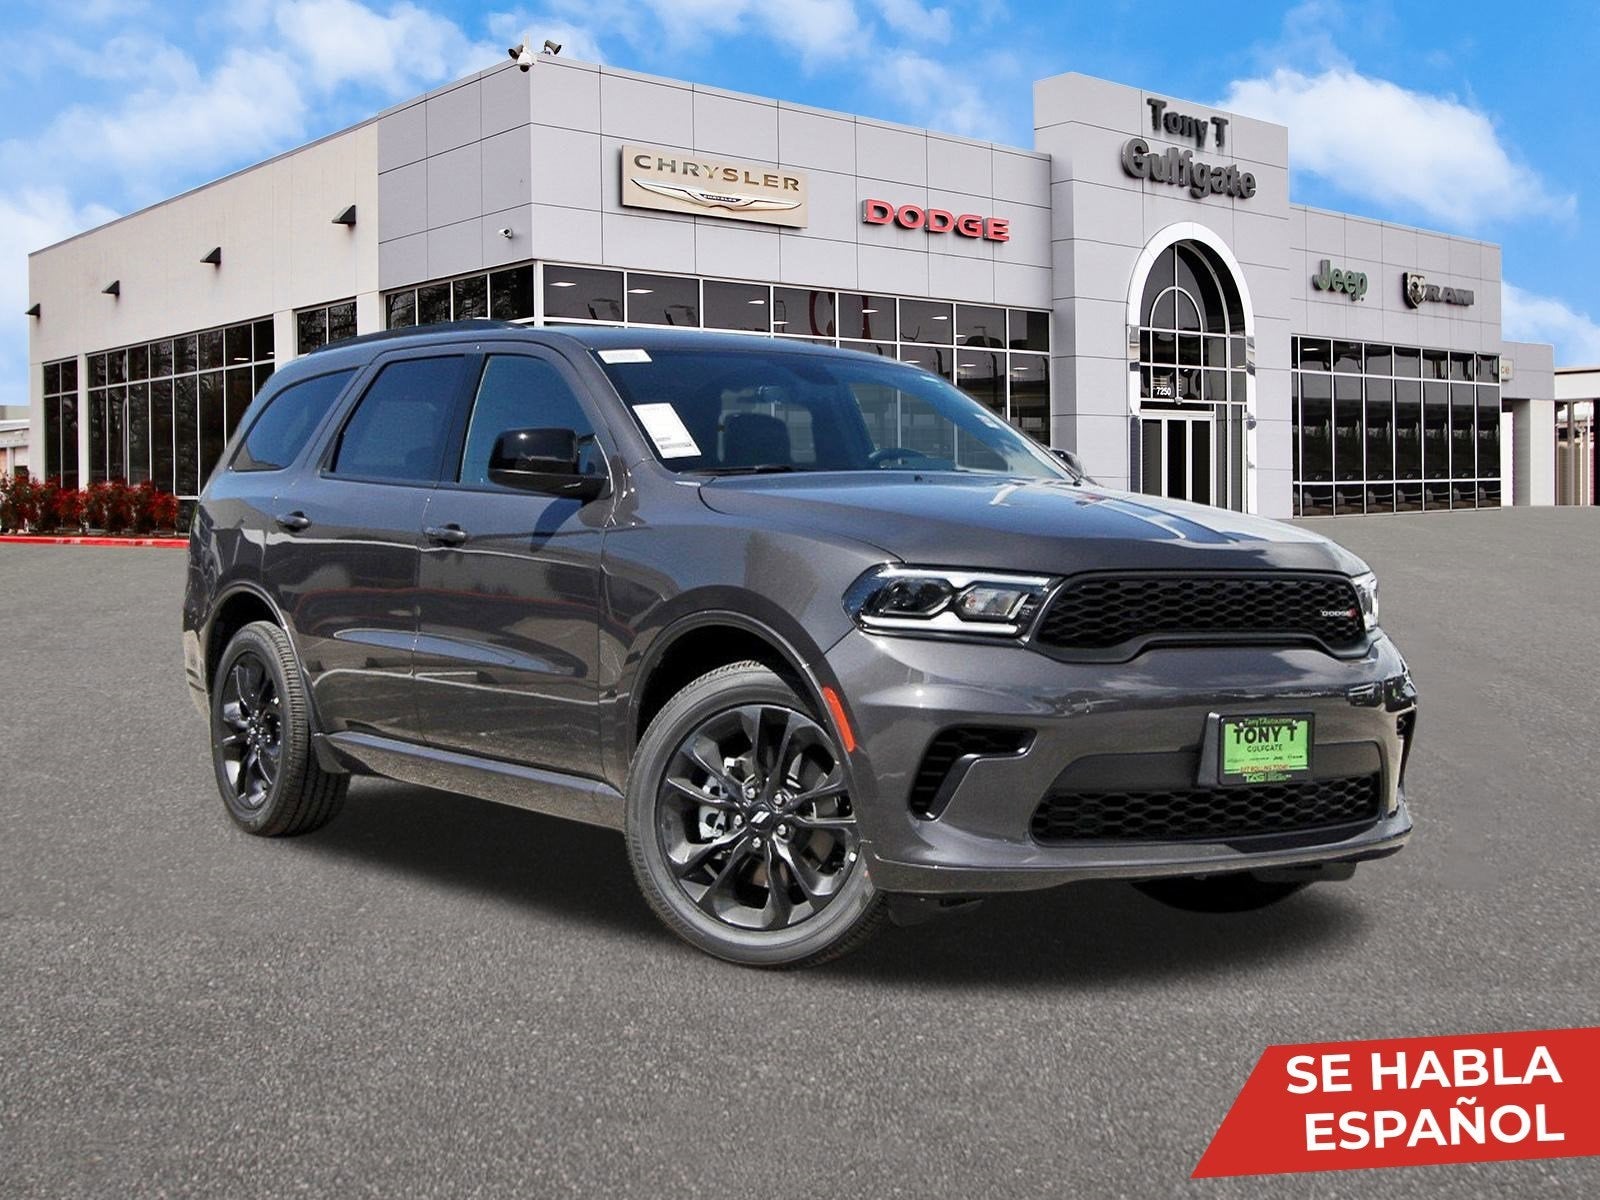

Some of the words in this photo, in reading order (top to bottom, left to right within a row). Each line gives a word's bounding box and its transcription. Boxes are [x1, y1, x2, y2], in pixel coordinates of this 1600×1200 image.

[1146, 98, 1208, 148] Tony
[1210, 116, 1229, 147] T
[634, 154, 800, 192] CHRYSLER
[1121, 138, 1256, 199] Gulfgate
[862, 198, 1010, 242] DODGE
[1312, 259, 1368, 302] Jeep
[1424, 284, 1474, 306] RAM
[1233, 726, 1282, 745] TONY
[1287, 725, 1298, 742] T
